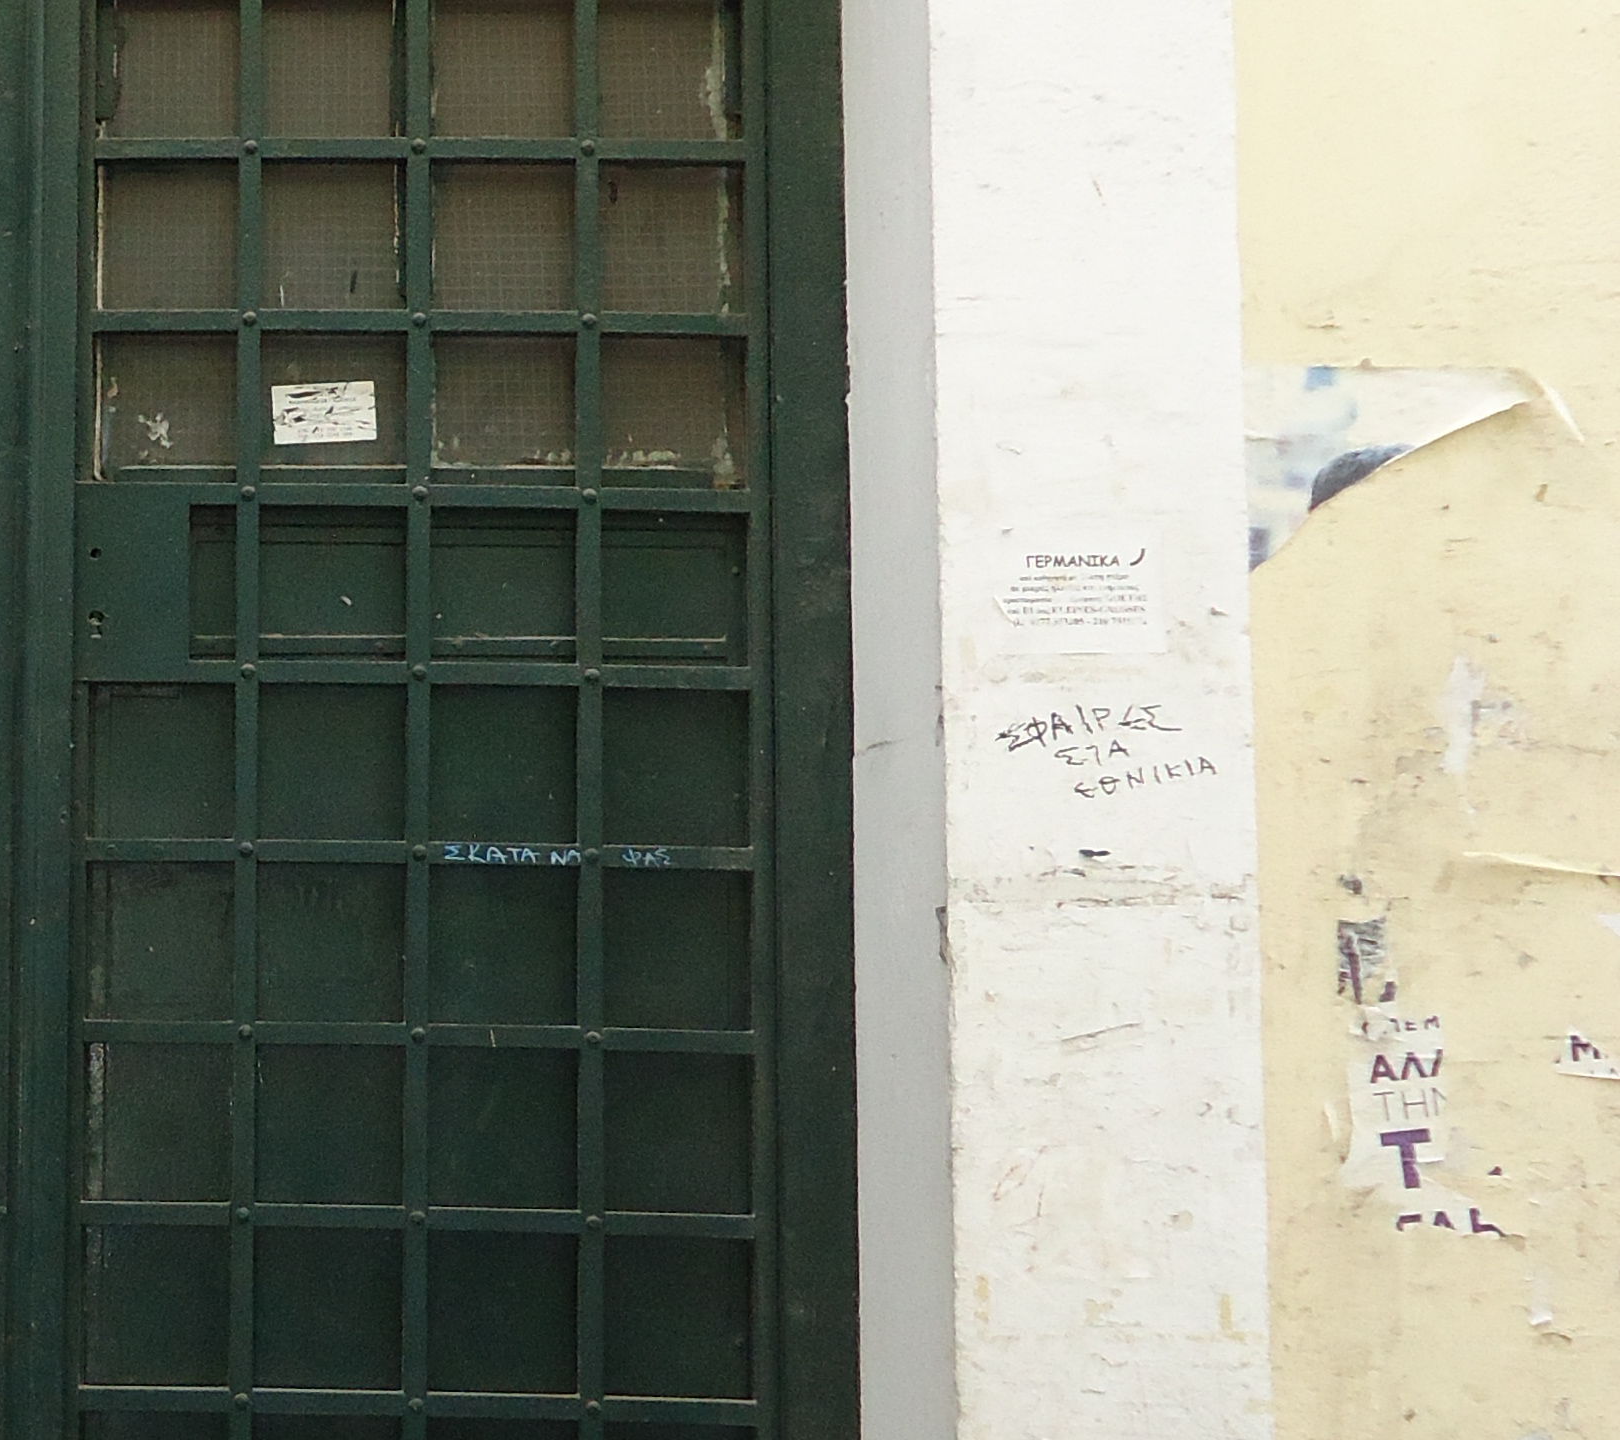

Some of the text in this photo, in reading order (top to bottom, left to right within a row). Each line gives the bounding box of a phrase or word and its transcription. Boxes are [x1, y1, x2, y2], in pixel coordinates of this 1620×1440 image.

[1025, 553, 1121, 569] ΓΕΡΜΑΝΙΚΑ
[1054, 738, 1130, 766] ΣΤΑ
[443, 843, 542, 864] ΣΚΑΤΑ
[549, 849, 582, 866] ΝΑ
